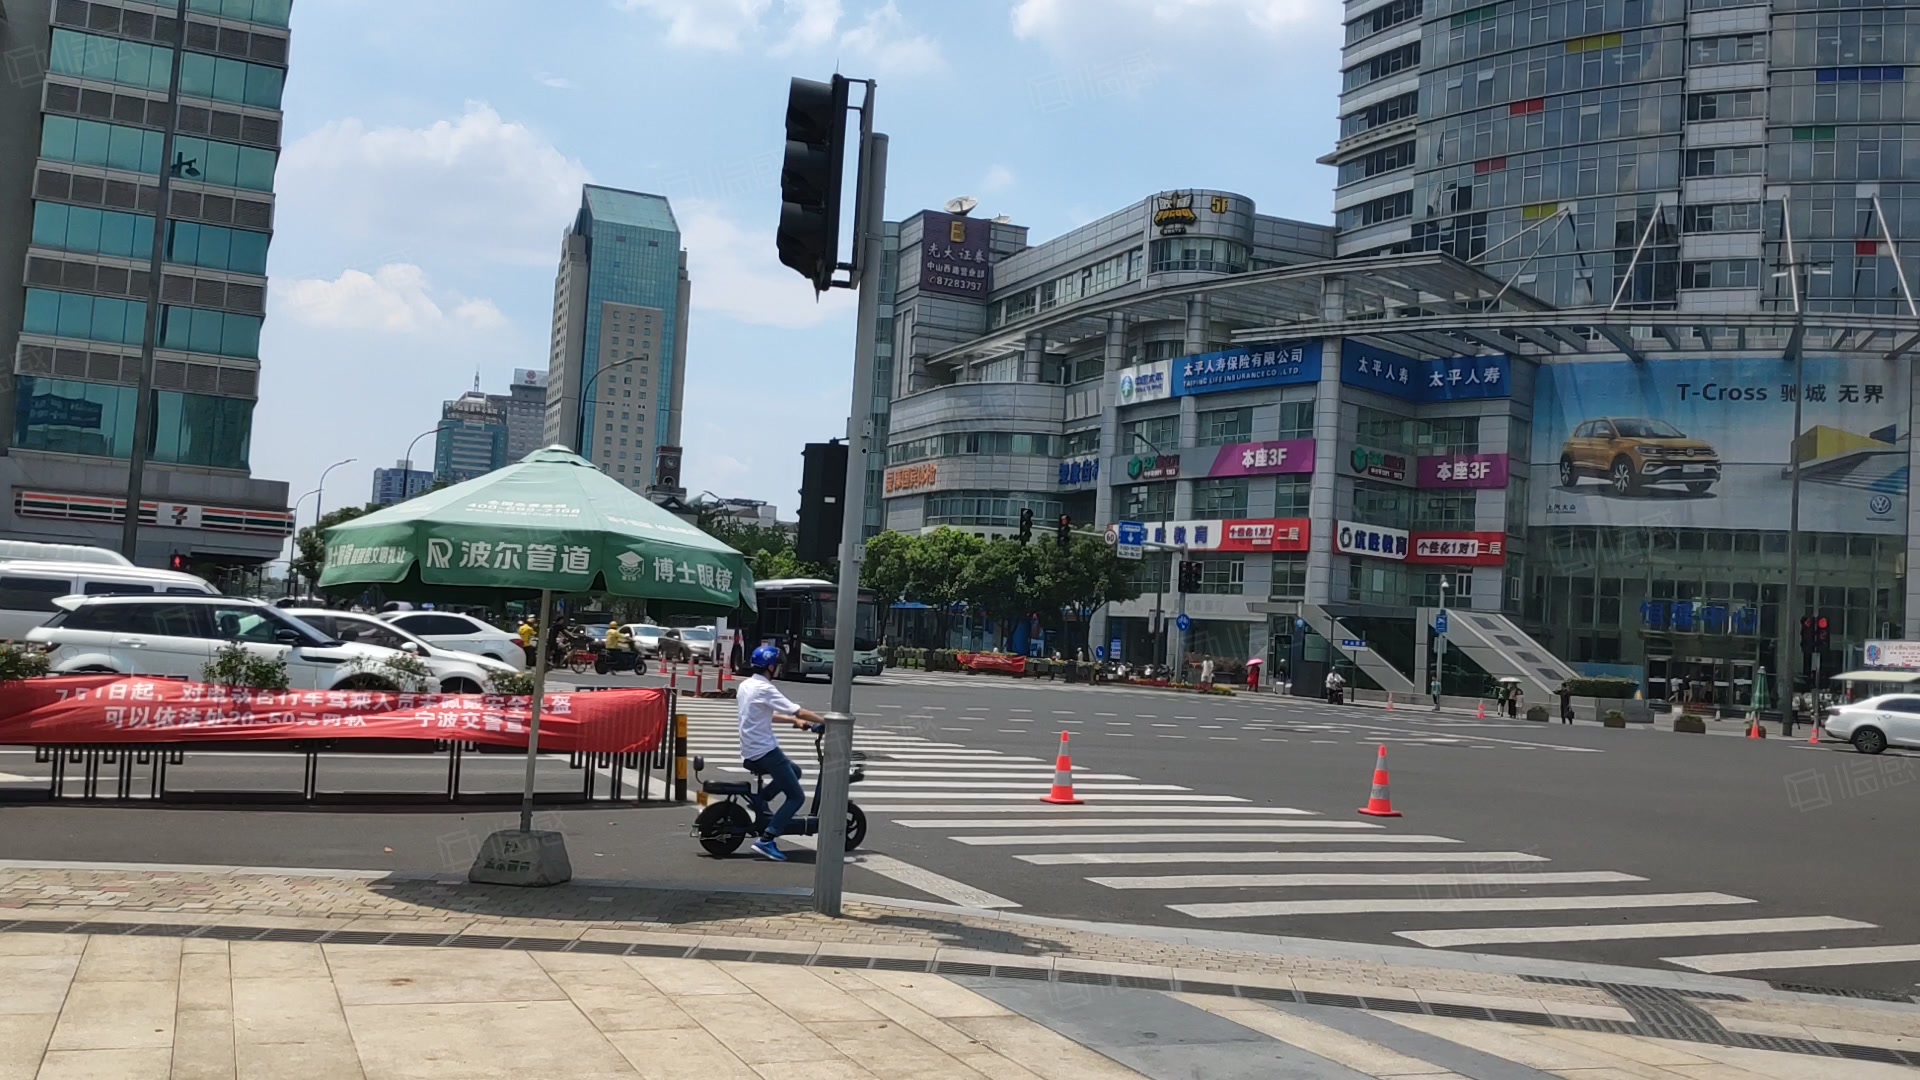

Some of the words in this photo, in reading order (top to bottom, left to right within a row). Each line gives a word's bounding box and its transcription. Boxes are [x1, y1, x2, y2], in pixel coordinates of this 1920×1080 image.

[928, 242, 987, 263] 光大证券
[936, 276, 982, 291] 87283797
[1183, 348, 1303, 377] 太平人寿保险有限公司
[1358, 357, 1409, 385] 太平人寿
[1429, 367, 1500, 387] 太平人寿
[1677, 383, 1768, 401] T-Cross
[1838, 384, 1884, 403] 无界
[1241, 448, 1288, 468] 本座3F
[1436, 461, 1492, 481] 本座3F
[1106, 532, 1115, 542] 60
[459, 541, 592, 575] 波尔管道
[653, 557, 733, 592] 博士眼镜
